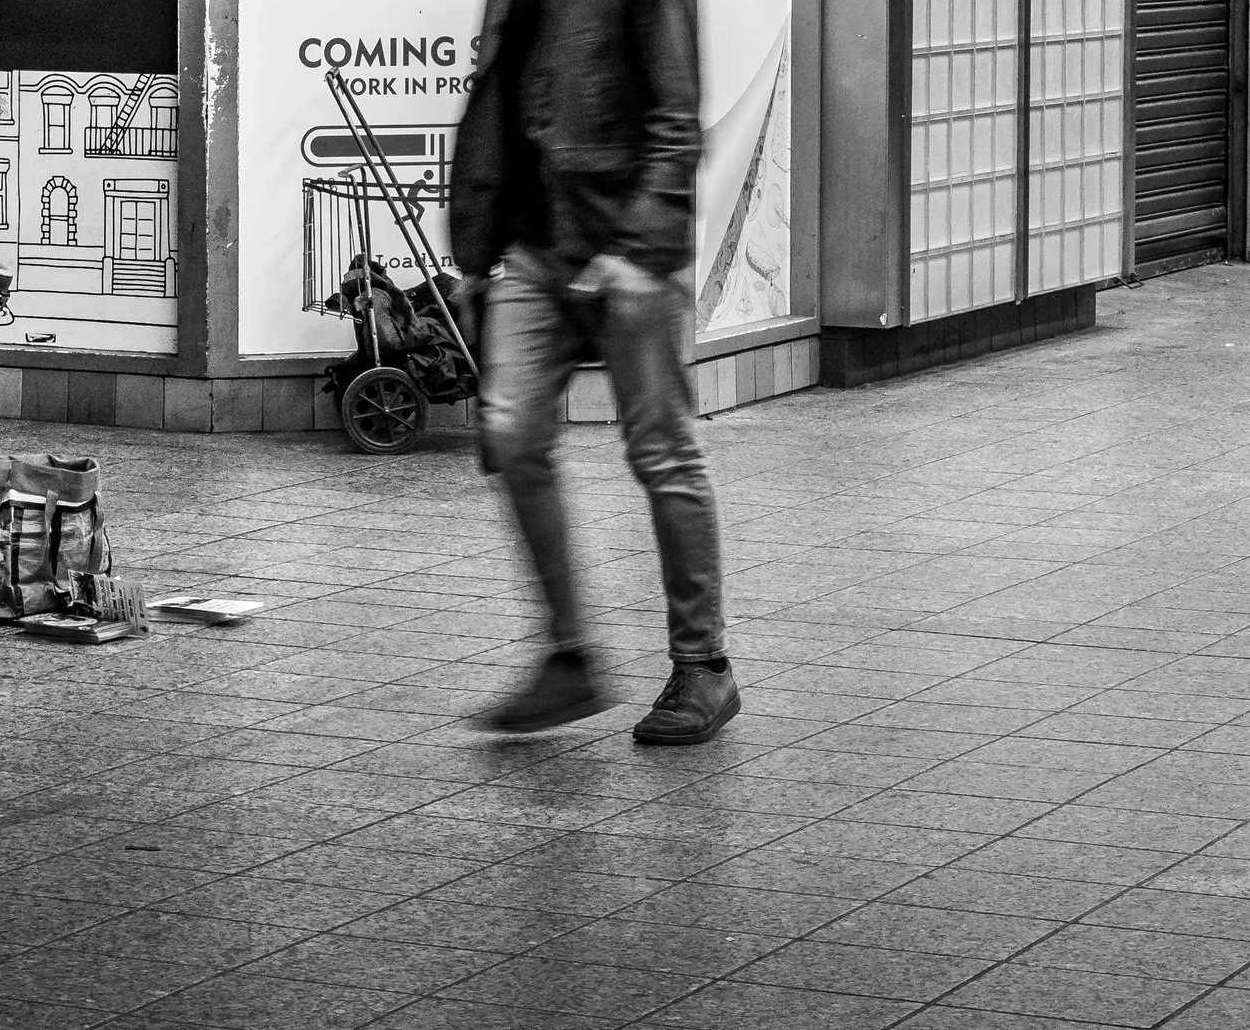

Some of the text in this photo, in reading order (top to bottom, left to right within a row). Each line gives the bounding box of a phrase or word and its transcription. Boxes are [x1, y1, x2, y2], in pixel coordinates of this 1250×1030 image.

[299, 36, 456, 68] COMING
[405, 77, 427, 95] IN
[375, 252, 453, 269] Loadn
